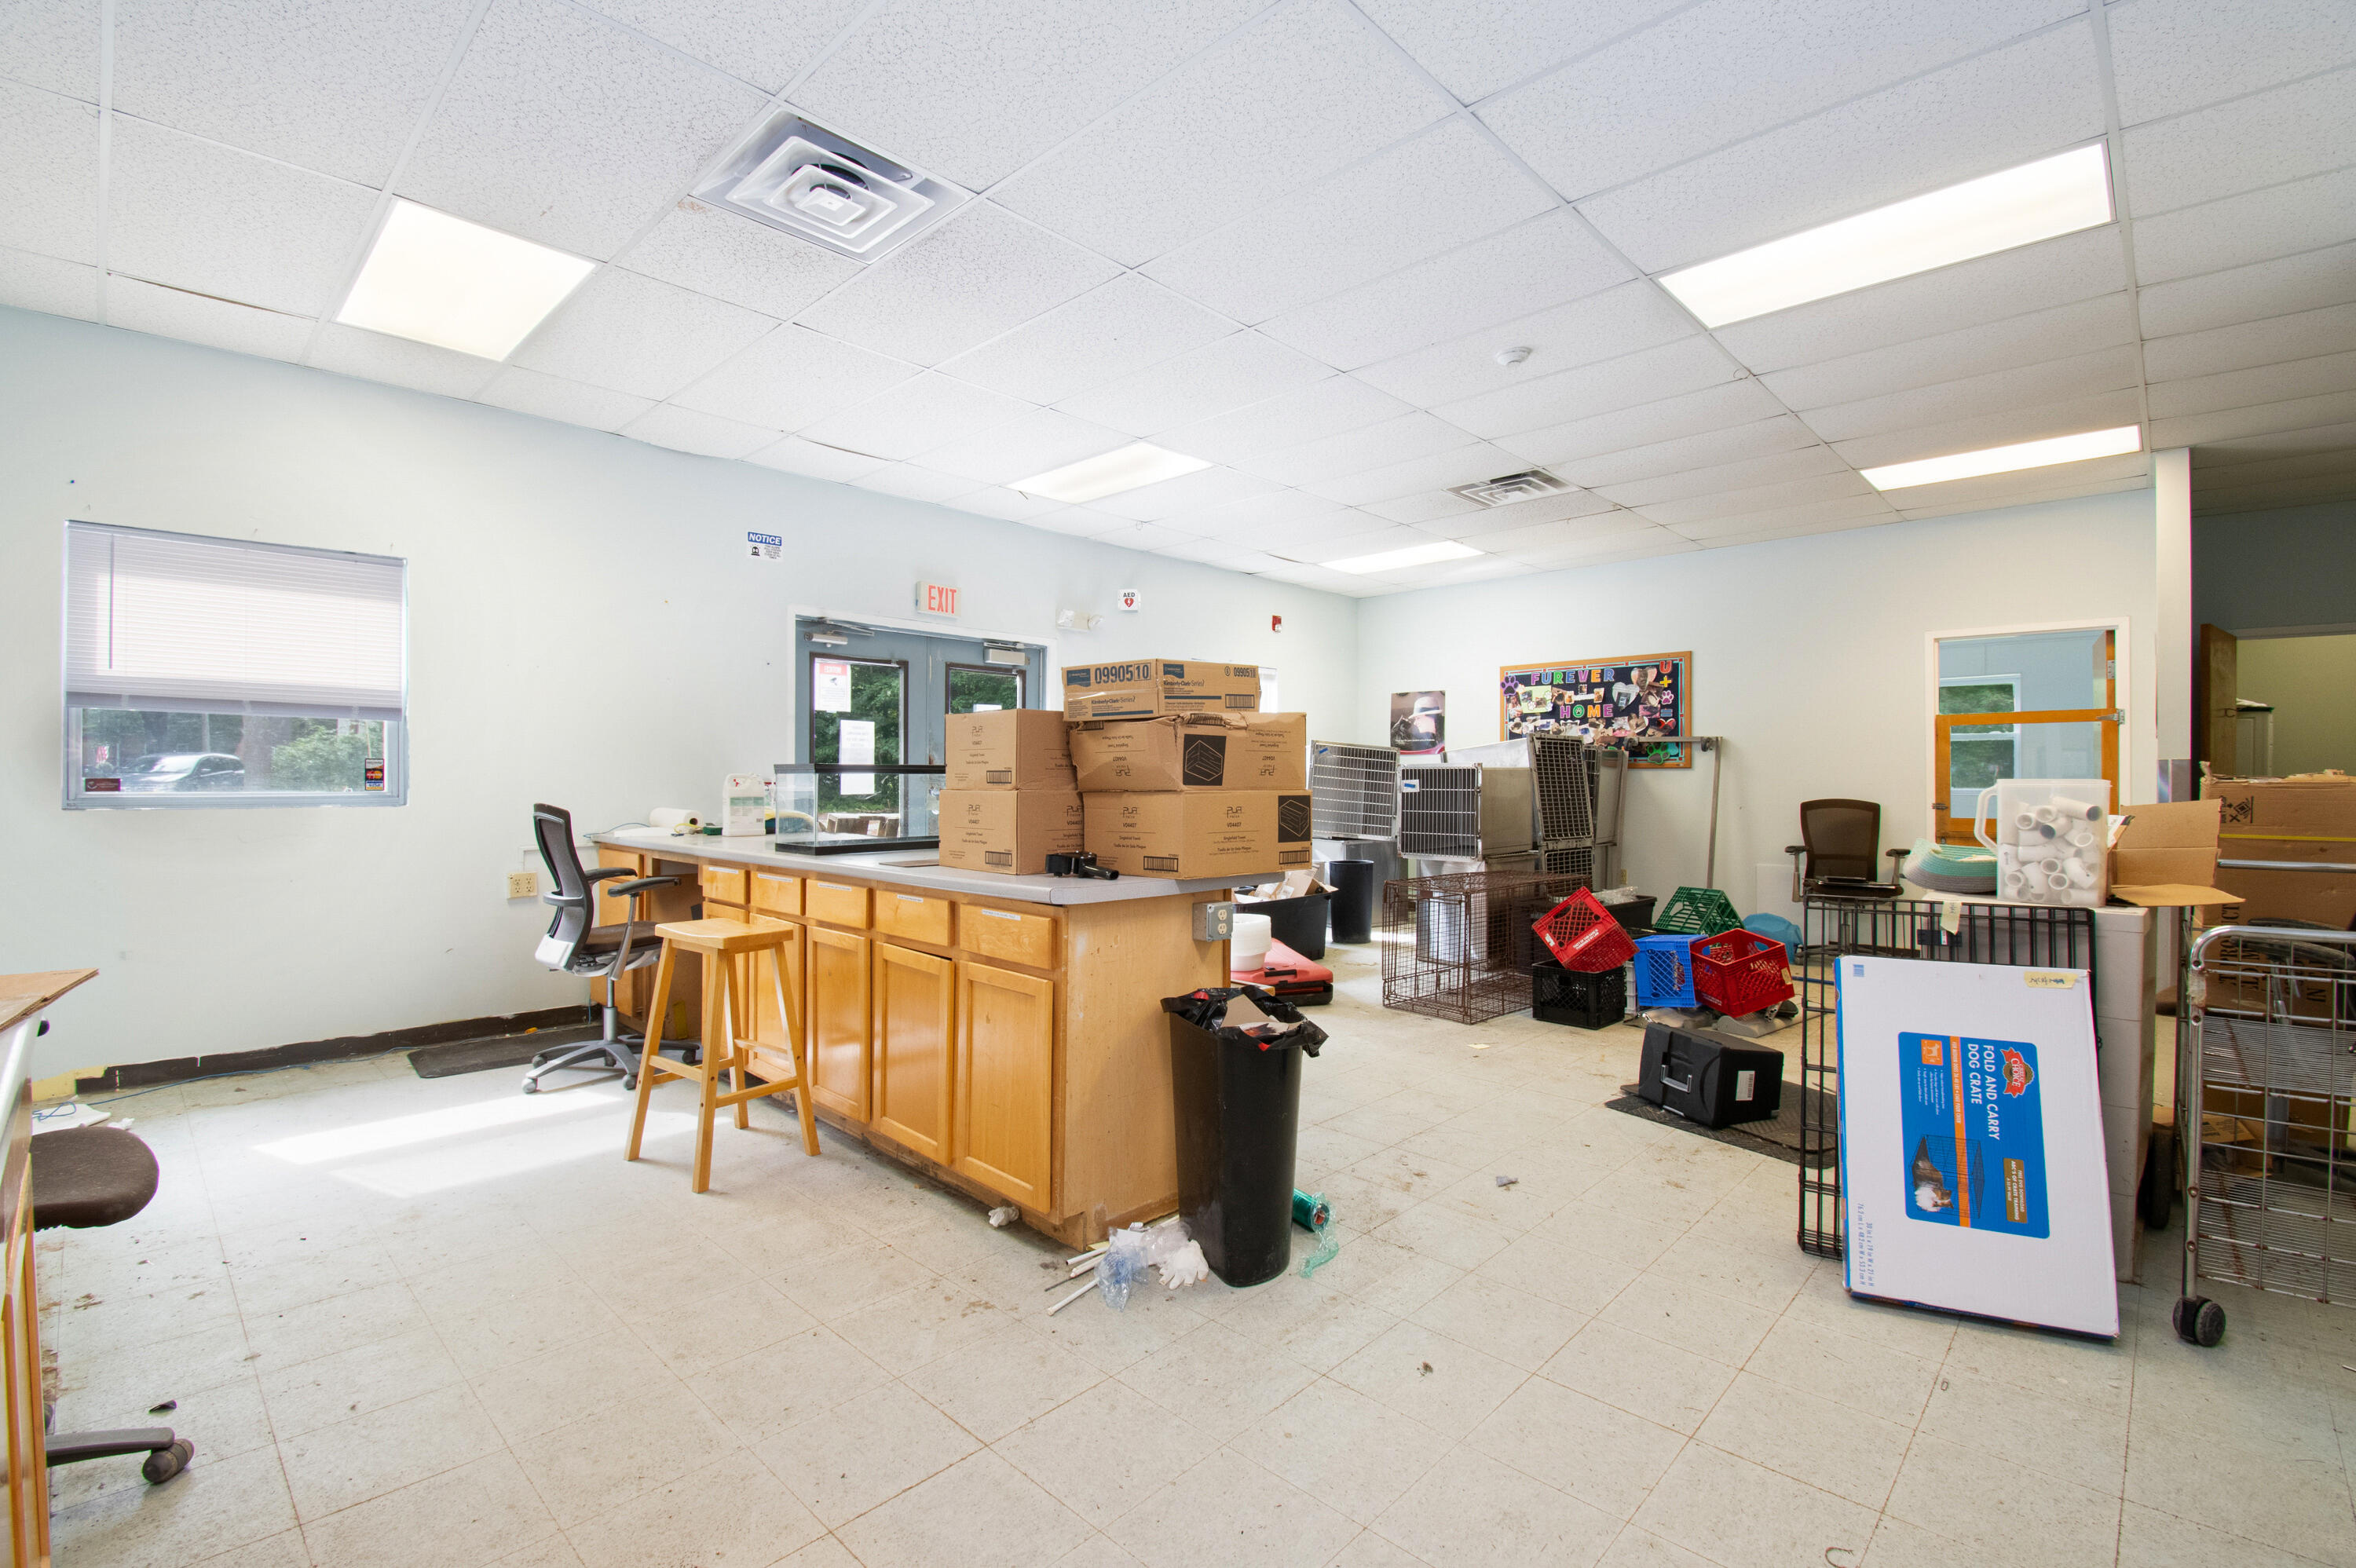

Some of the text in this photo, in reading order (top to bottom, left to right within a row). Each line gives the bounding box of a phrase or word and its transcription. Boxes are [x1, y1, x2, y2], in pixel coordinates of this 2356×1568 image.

[748, 533, 781, 545] NOTICE
[927, 584, 957, 614] EXIT
[1094, 664, 1150, 684] 0990510
[1531, 668, 1615, 685] FUREVER
[1560, 704, 1613, 718] HOME
[1968, 1044, 1982, 1105] DOG CRATE
[2010, 1058, 2021, 1087] CHOICE
[1983, 1045, 1999, 1141] FOLD AND CARRY
